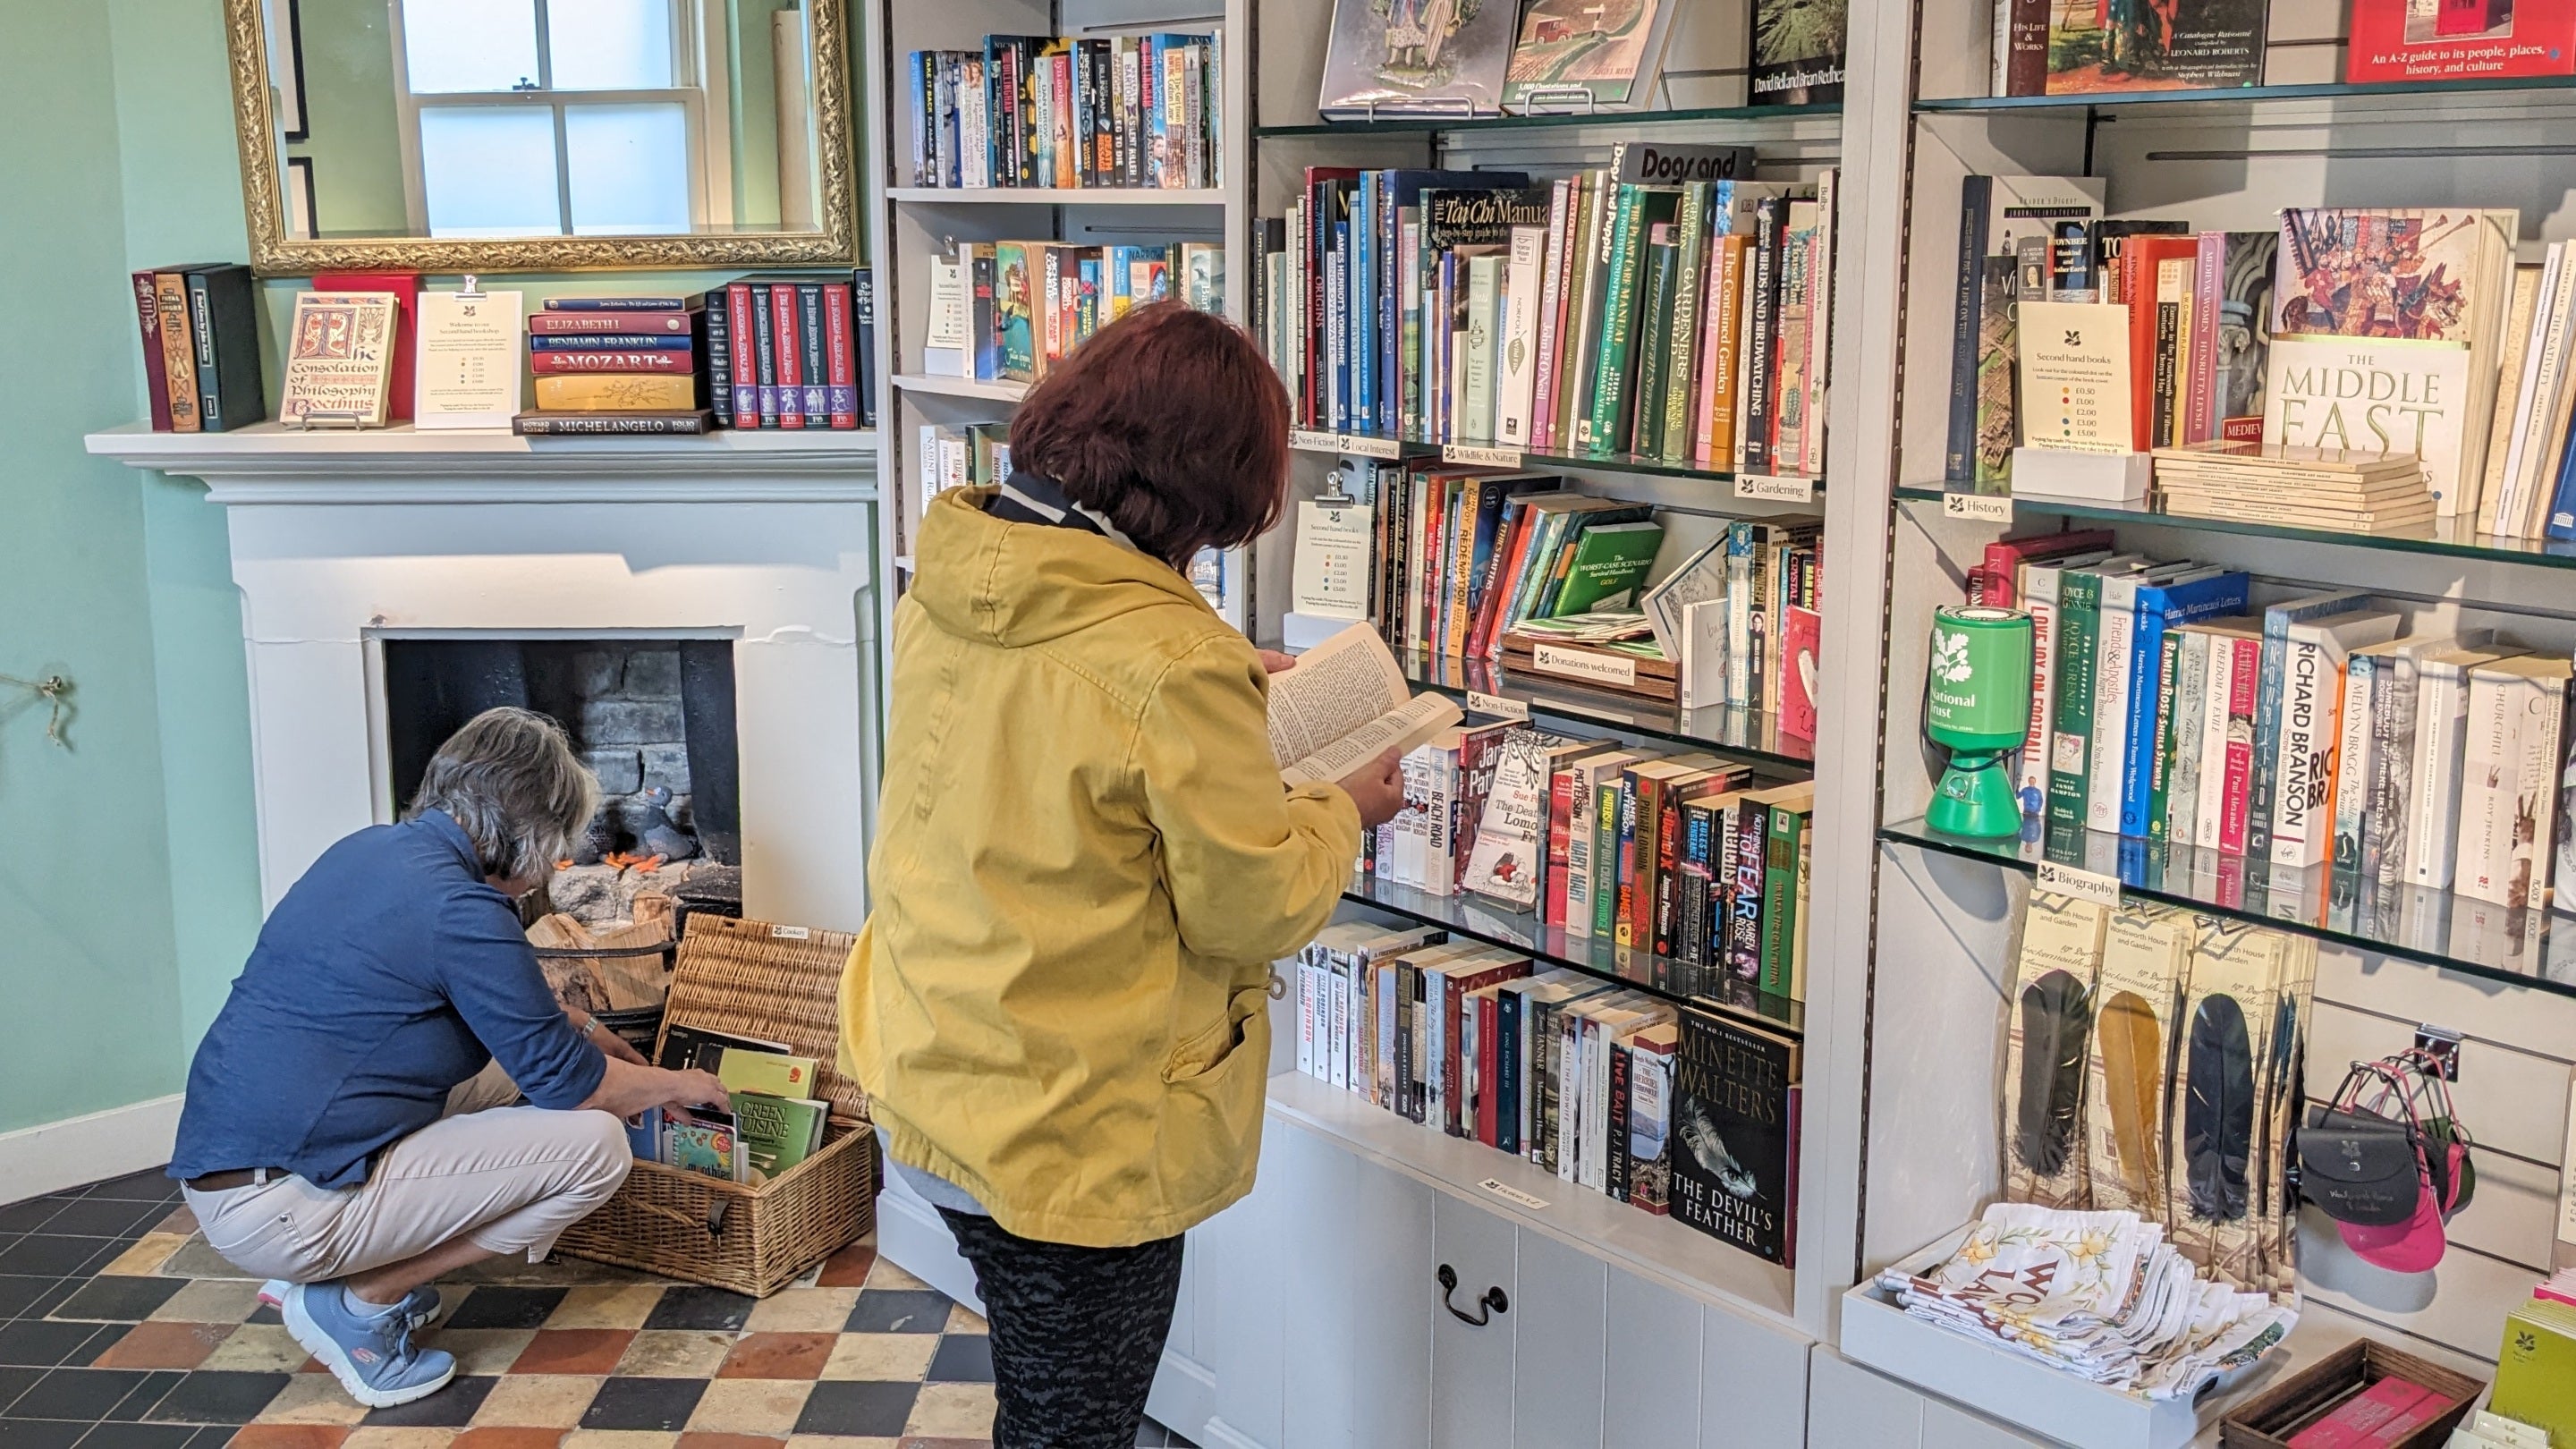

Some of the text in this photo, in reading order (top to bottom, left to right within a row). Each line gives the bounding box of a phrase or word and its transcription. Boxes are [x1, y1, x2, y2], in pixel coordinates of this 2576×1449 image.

[2013, 22, 2046, 32] HIS LIFE
[2025, 32, 2033, 41] &
[2013, 42, 2044, 52] WORKS
[2171, 47, 2250, 57] LEONARD ROBERTS
[2372, 44, 2546, 64] An A-Z guide to its people, places,
[1754, 64, 1846, 94] David Bell and Brian Redhea
[2177, 70, 2241, 80] Stephen Wildman
[2405, 61, 2504, 76] history, and culture
[1098, 64, 1106, 114] BILLINGHAM
[1641, 148, 1737, 185] Dogs and
[1434, 199, 1445, 224] THE
[1445, 199, 1550, 224] Tai Chi Manua
[1601, 146, 1624, 265] Dogs and Puppies
[2053, 196, 2078, 205] DIGEST
[1679, 191, 1699, 250] GEOFF HAMILTON
[1545, 189, 1564, 304] FAVOURITE CATS
[1316, 275, 1325, 329] ORIGINS
[1336, 231, 1345, 367] JAMES HERRIOT'S YORKSHIRE
[546, 319, 612, 330] ELIZABETH
[1670, 267, 1695, 382] GARDENERS' WORLD
[1716, 250, 1737, 395] The Contained Garden
[548, 336, 658, 348] BENJAMIN FRANKLIN
[1750, 251, 1769, 417] BIRDS AND BIRDWATCHING
[2194, 250, 2214, 431] MEDIEVAL WOMEN HENRIETTA LEYSER
[291, 361, 379, 374] Consolation
[566, 355, 658, 369] MOZART
[2036, 352, 2112, 365] Second hand books
[2346, 354, 2375, 366] THE
[290, 374, 309, 385] of
[2281, 364, 2441, 405] MIDDLE
[291, 385, 376, 397] Philosophy
[2075, 387, 2096, 395] £0.50
[2076, 408, 2097, 416] £2.00
[2076, 419, 2097, 427] £3.00
[559, 420, 665, 432] MICHELANGELO
[2077, 429, 2097, 437] £5.00
[2279, 397, 2445, 462] EAST
[1298, 435, 1336, 449] Non-Fiction
[1351, 440, 1396, 456] Local Interest
[1456, 448, 1484, 462] Wildlife
[1492, 451, 1519, 464] Nature
[1756, 480, 1805, 499] Gardening
[1966, 499, 2007, 516] History
[1310, 524, 1329, 532] Second
[1343, 526, 1360, 534] books
[1455, 529, 1469, 607] REDEMPTION
[1485, 522, 1509, 592] ETHICS MATTERS
[1580, 558, 1653, 572] WORST-CASE SCENARIO
[1599, 578, 1618, 587] GOLF
[1789, 556, 1799, 602] CRYSTAL
[2062, 597, 2092, 613] GINNIE
[2164, 594, 2241, 620] Harriet Martineau's Letters
[1551, 655, 1631, 677] Donations welcomed
[1481, 698, 1526, 715] Non-Fiction
[1930, 686, 1976, 708] National
[1929, 702, 1952, 719] Trust
[2258, 624, 2279, 807] SNOWBLIND
[2491, 682, 2506, 758] CHURCHILL
[2284, 640, 2316, 828] RICHARD BRANSON
[1431, 790, 1445, 823] BEACH
[1513, 790, 1529, 801] Sue
[1495, 799, 1538, 818] The Deat
[1429, 822, 1444, 849] ROAD
[1751, 812, 1767, 855] NOTHING
[2482, 814, 2493, 861] JENKINS
[1734, 848, 1761, 921] FEAR
[2057, 870, 2116, 897] Biography
[2039, 913, 2078, 928] and Garden
[2072, 910, 2094, 923] House
[782, 927, 806, 937] Cookery
[1733, 915, 1747, 943] ROSE
[1743, 919, 1758, 953] KAREN
[2109, 924, 2168, 947] Wordsworth House
[2116, 936, 2153, 953] and Garden
[2199, 938, 2266, 960] Wordsworth House
[1690, 1020, 1767, 1054] THE NO.1 BESTSELLER
[1536, 1033, 1546, 1071] TANNER
[1677, 1021, 1778, 1091] MINETTE
[1614, 1051, 1626, 1087] LIVE
[1633, 1072, 1658, 1089] HERRIES
[1676, 1056, 1776, 1124] WALTERS
[739, 1100, 788, 1123] GREEN
[1613, 1089, 1625, 1127] BAIT
[740, 1115, 791, 1140] UISINE
[1535, 1120, 1544, 1141] House
[1612, 1150, 1623, 1184] TRACY
[1673, 1172, 1774, 1233] THE DEVIL'S
[1684, 1199, 1758, 1248] FEATHER
